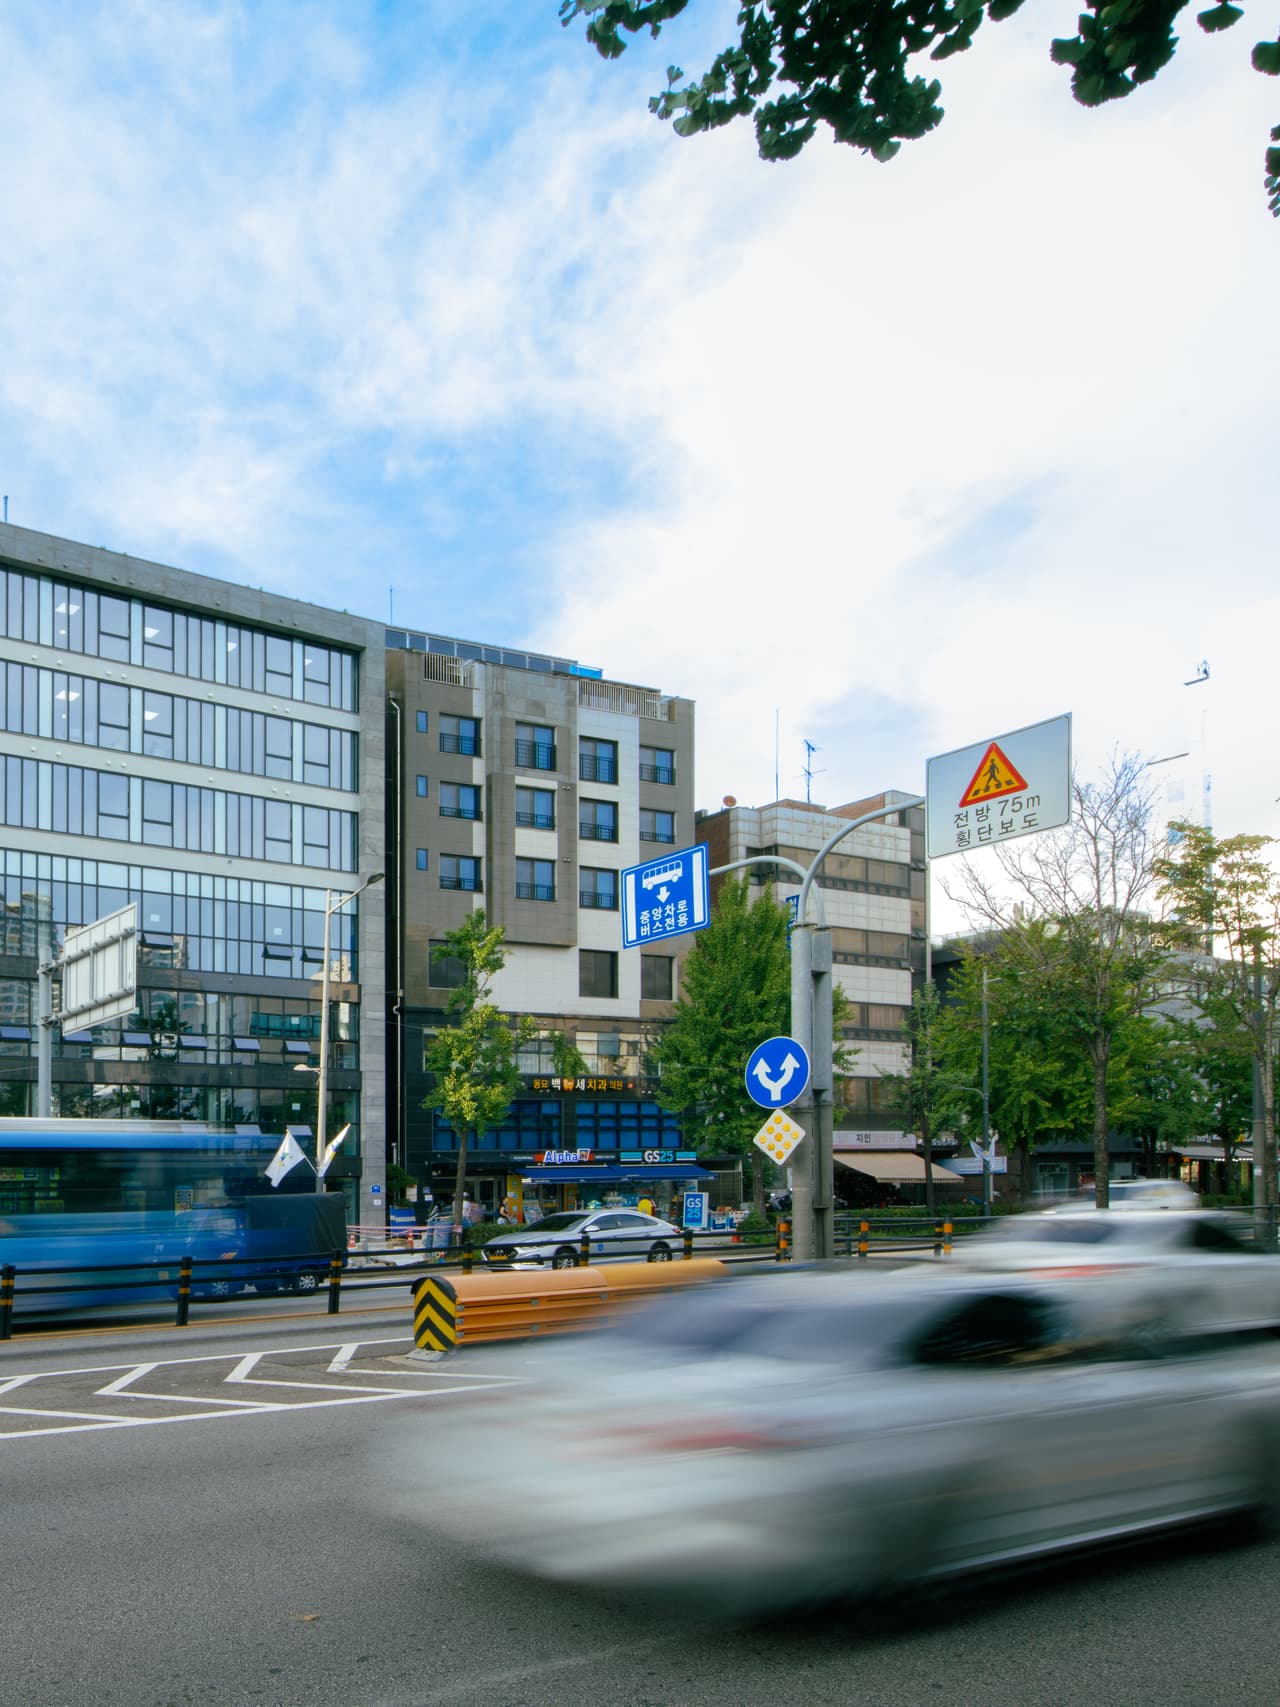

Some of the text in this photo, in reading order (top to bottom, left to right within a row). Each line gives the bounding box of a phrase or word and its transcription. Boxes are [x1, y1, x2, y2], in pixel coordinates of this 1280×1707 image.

[953, 794, 1041, 829] 전방 75m
[955, 812, 1040, 848] 횡단보도
[639, 899, 689, 925] 중앙차로
[640, 912, 689, 937] 버스전용
[544, 1150, 578, 1163] Alpha
[644, 1150, 675, 1163] GS25
[686, 1198, 702, 1208] GS
[686, 1208, 701, 1219] 25
